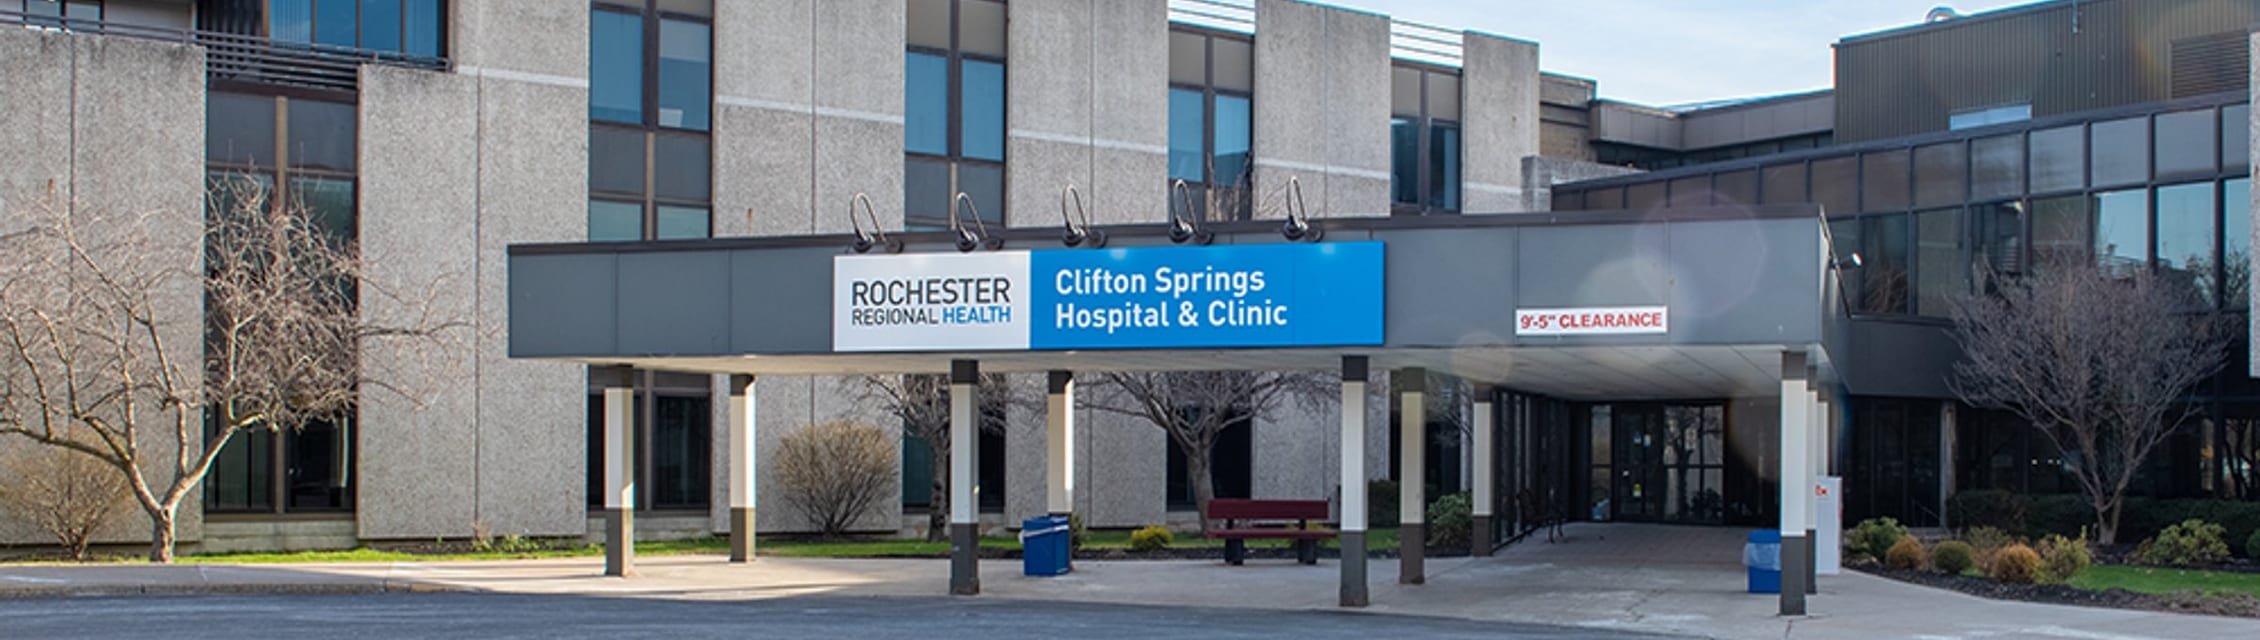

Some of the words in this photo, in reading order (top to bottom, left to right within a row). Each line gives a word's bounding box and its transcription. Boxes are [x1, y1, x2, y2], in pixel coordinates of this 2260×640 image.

[851, 277, 1011, 306] ROCHESTER
[1056, 268, 1147, 295] Clifton
[1154, 265, 1266, 299] Springs
[851, 308, 939, 326] REGIONAL
[942, 306, 1011, 324] HEALTH
[1056, 301, 1170, 334] Hospital
[1178, 300, 1199, 327] &
[1207, 298, 1288, 327] Clinic
[1559, 312, 1662, 329] CLEARANCE
